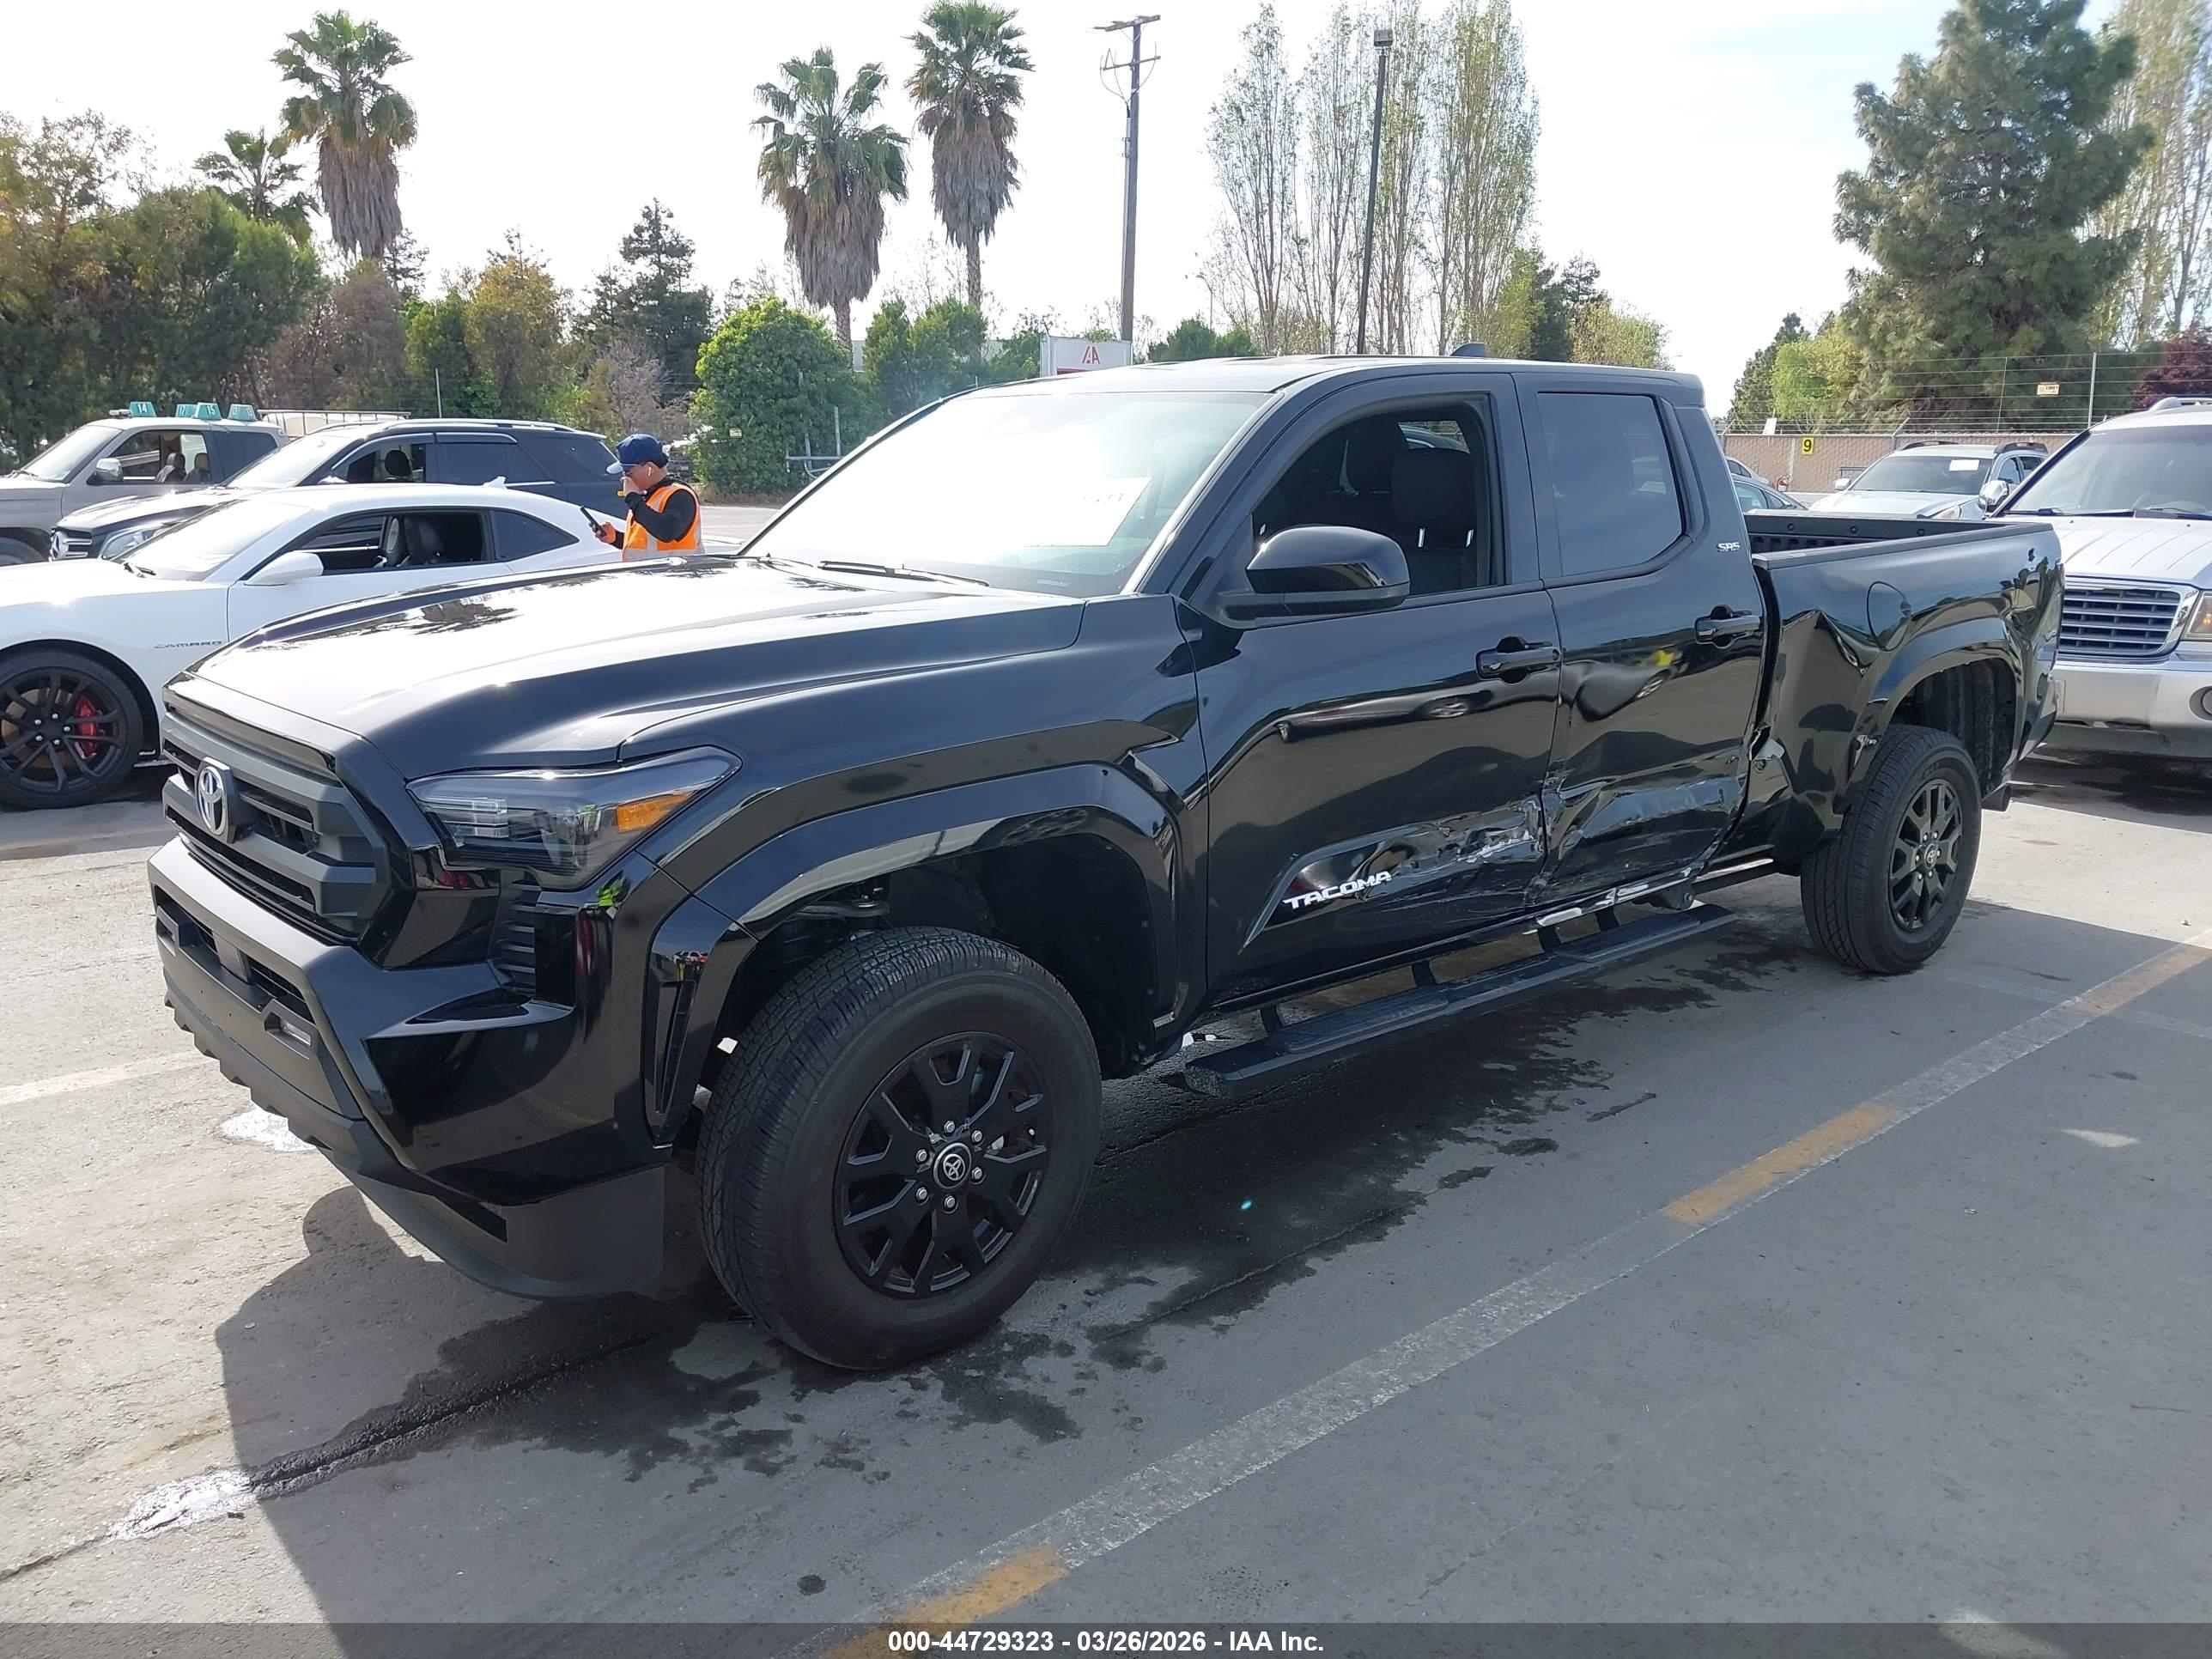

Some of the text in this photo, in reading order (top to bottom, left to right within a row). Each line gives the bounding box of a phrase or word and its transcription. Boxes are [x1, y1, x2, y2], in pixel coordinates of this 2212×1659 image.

[137, 404, 148, 413] 14
[207, 405, 216, 416] 15
[1803, 439, 1812, 453] 9
[1717, 542, 1741, 552] SR5
[1282, 870, 1392, 909] TACOMA
